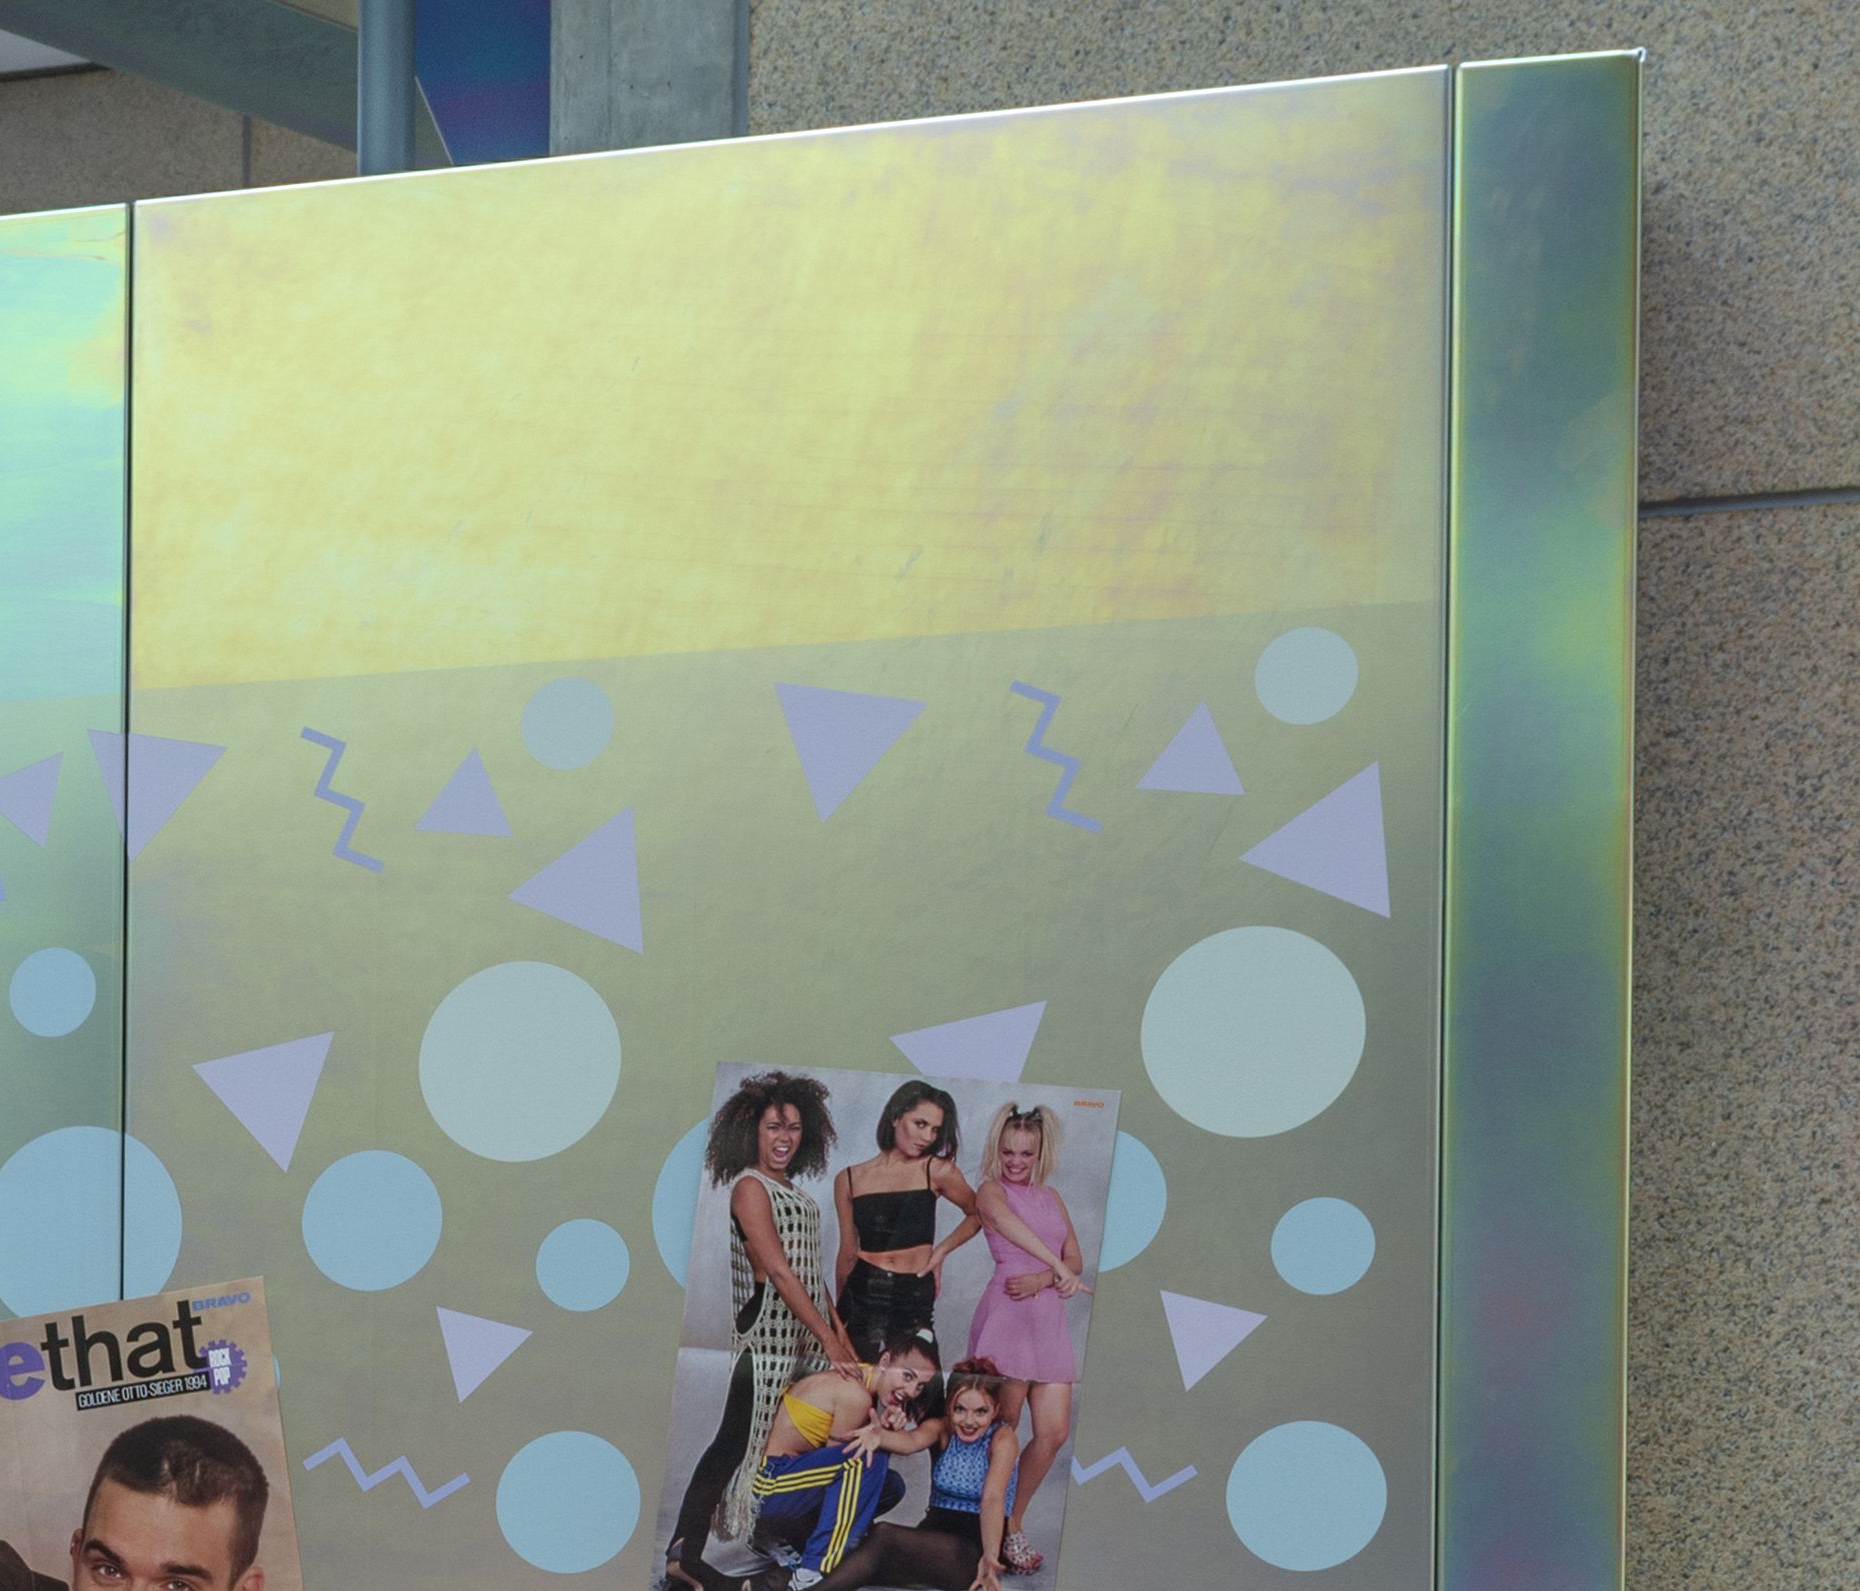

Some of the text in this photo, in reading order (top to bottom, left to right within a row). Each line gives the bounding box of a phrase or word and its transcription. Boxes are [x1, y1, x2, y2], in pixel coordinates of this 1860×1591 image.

[192, 1292, 250, 1312] BRAVO
[208, 1348, 232, 1368] ROCK
[212, 1367, 231, 1386] POP
[78, 1375, 208, 1408] GOLDENE OTTO-SIEGER 1994
